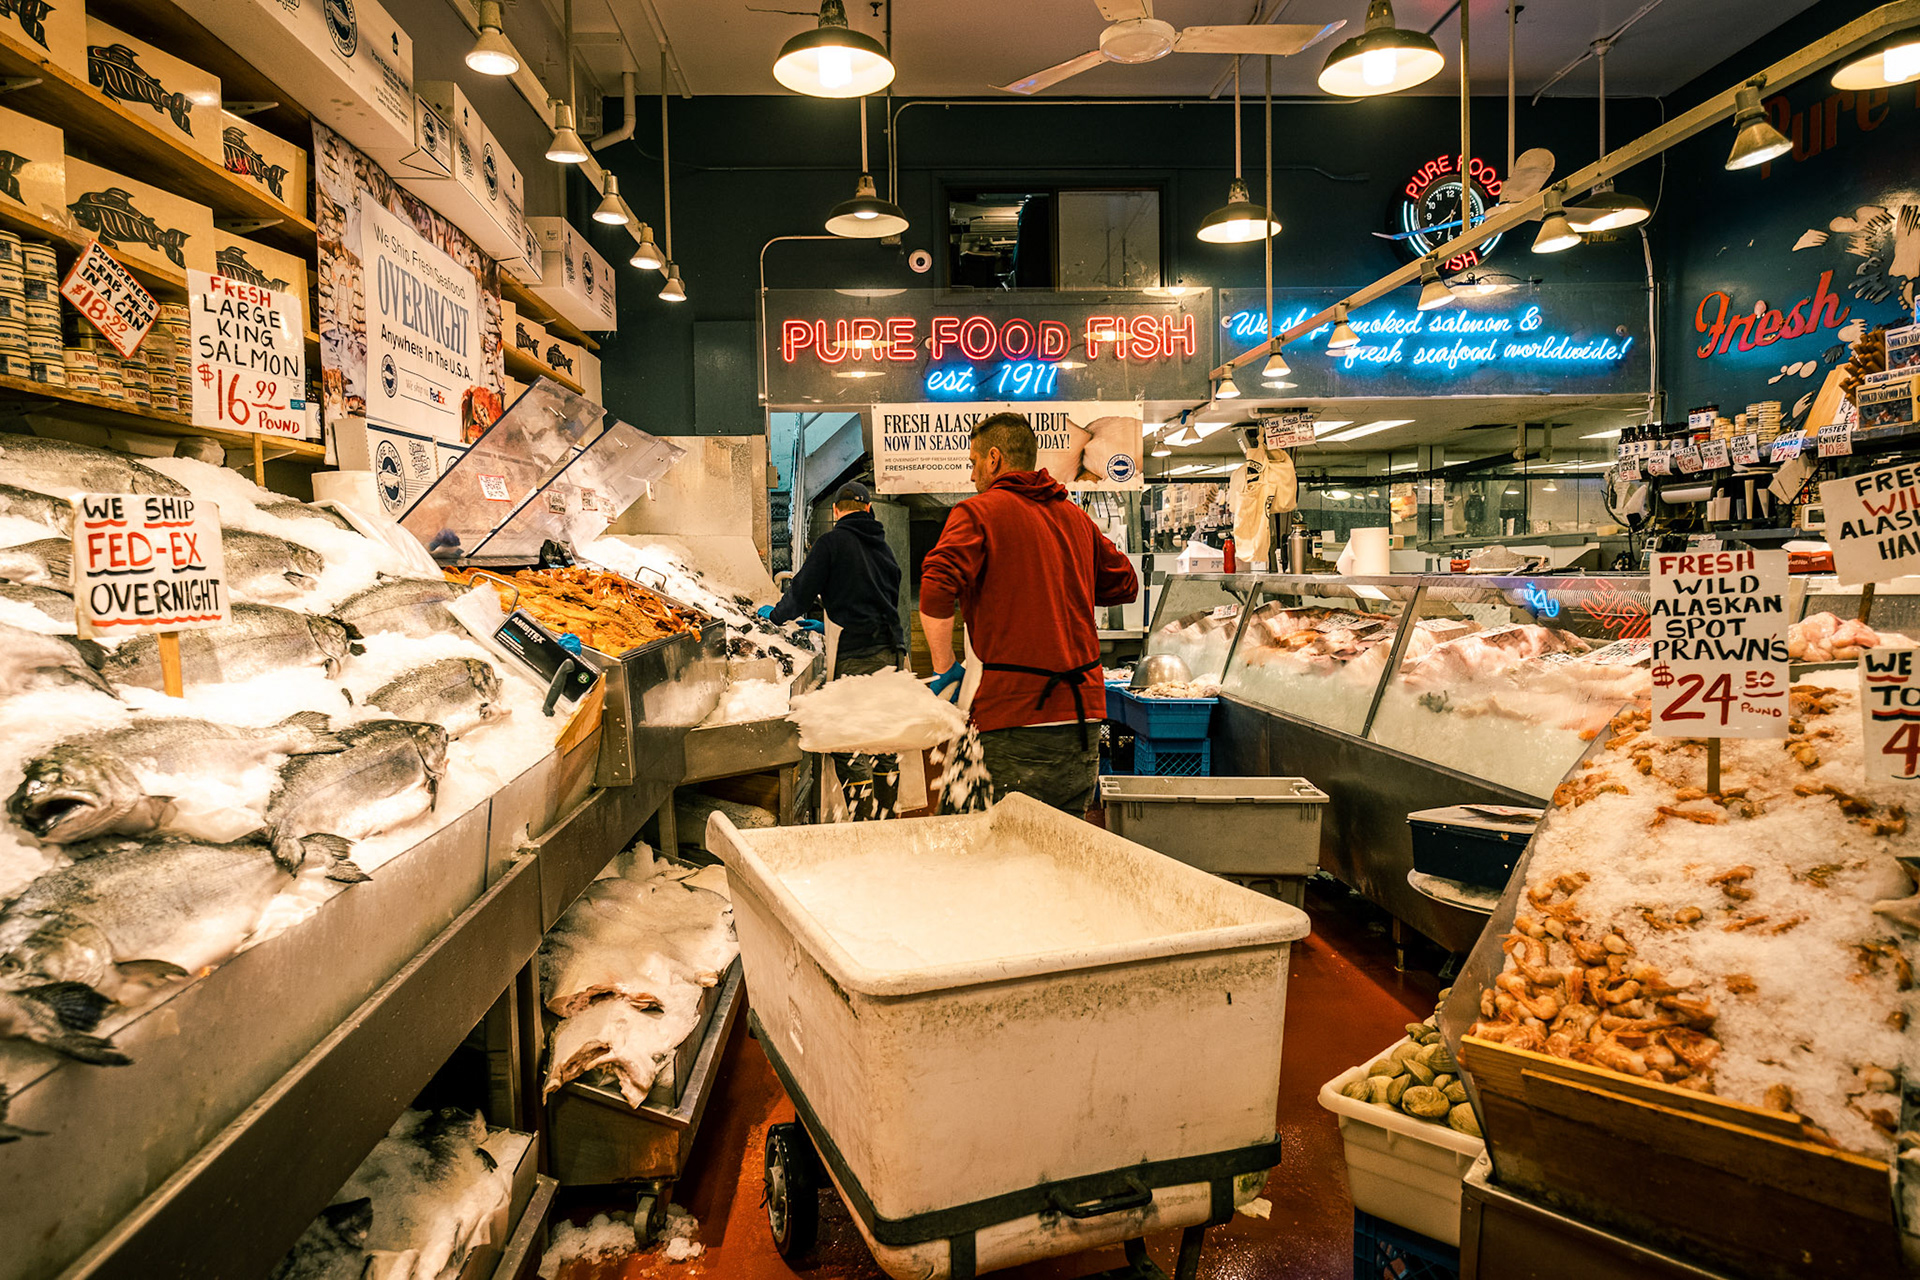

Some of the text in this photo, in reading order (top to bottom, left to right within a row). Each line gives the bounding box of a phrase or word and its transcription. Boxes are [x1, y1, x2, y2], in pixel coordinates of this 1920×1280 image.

[1405, 154, 1453, 200] PURE
[1428, 202, 1436, 210] 10
[1436, 193, 1443, 201] 11
[1446, 190, 1455, 198] 12
[1426, 212, 1432, 220] 9
[373, 222, 466, 300] We Ship Fresh Seafood
[1445, 250, 1478, 271] ISH
[88, 256, 154, 324] CRAB MEAT
[92, 244, 155, 312] DUNGENESS
[210, 276, 271, 308] FRESH
[82, 267, 145, 332] IN A CAN
[203, 294, 281, 329] LARGE
[377, 254, 469, 359] OVERNIGHT
[1232, 312, 1268, 336] We
[1344, 310, 1424, 334] moked
[1428, 310, 1512, 333] salmon
[1519, 306, 1540, 331] &
[1694, 269, 1852, 360] Fresh
[217, 318, 275, 350] KING
[782, 314, 1196, 364] PURE FOOD FISH
[199, 335, 299, 377] SALMON
[380, 323, 474, 382] Anywhere In The U.S.A.
[1344, 336, 1634, 370] fresh seafood worldwide!
[927, 363, 1058, 395] est. 1911
[429, 386, 446, 406] FedEx
[258, 410, 300, 434] POUND
[884, 413, 930, 434] FRESH
[1030, 412, 1070, 432] LIBUT
[1819, 424, 1848, 434] OYSTER
[884, 435, 912, 452] NOW
[914, 435, 926, 451] IN
[1036, 434, 1070, 450] ODAY!
[1818, 434, 1848, 444] KNIVES
[885, 464, 962, 472] FRESHSEAFOOD.COM
[1854, 466, 1920, 497] FRES
[83, 498, 195, 521] WE SHIP
[1862, 487, 1920, 517] WIL
[88, 532, 202, 569] FED-EX
[1659, 550, 1755, 576] FRESH
[90, 579, 220, 616] OVERNIGHT
[1672, 575, 1760, 595] WILD
[1652, 594, 1783, 617] ALASKAN
[512, 616, 547, 644] AMBITEX
[1666, 617, 1746, 639] SPOT
[1865, 651, 1913, 676] WE
[579, 674, 588, 683] XL
[1740, 702, 1782, 718] POUND
[1882, 722, 1920, 777] 4
